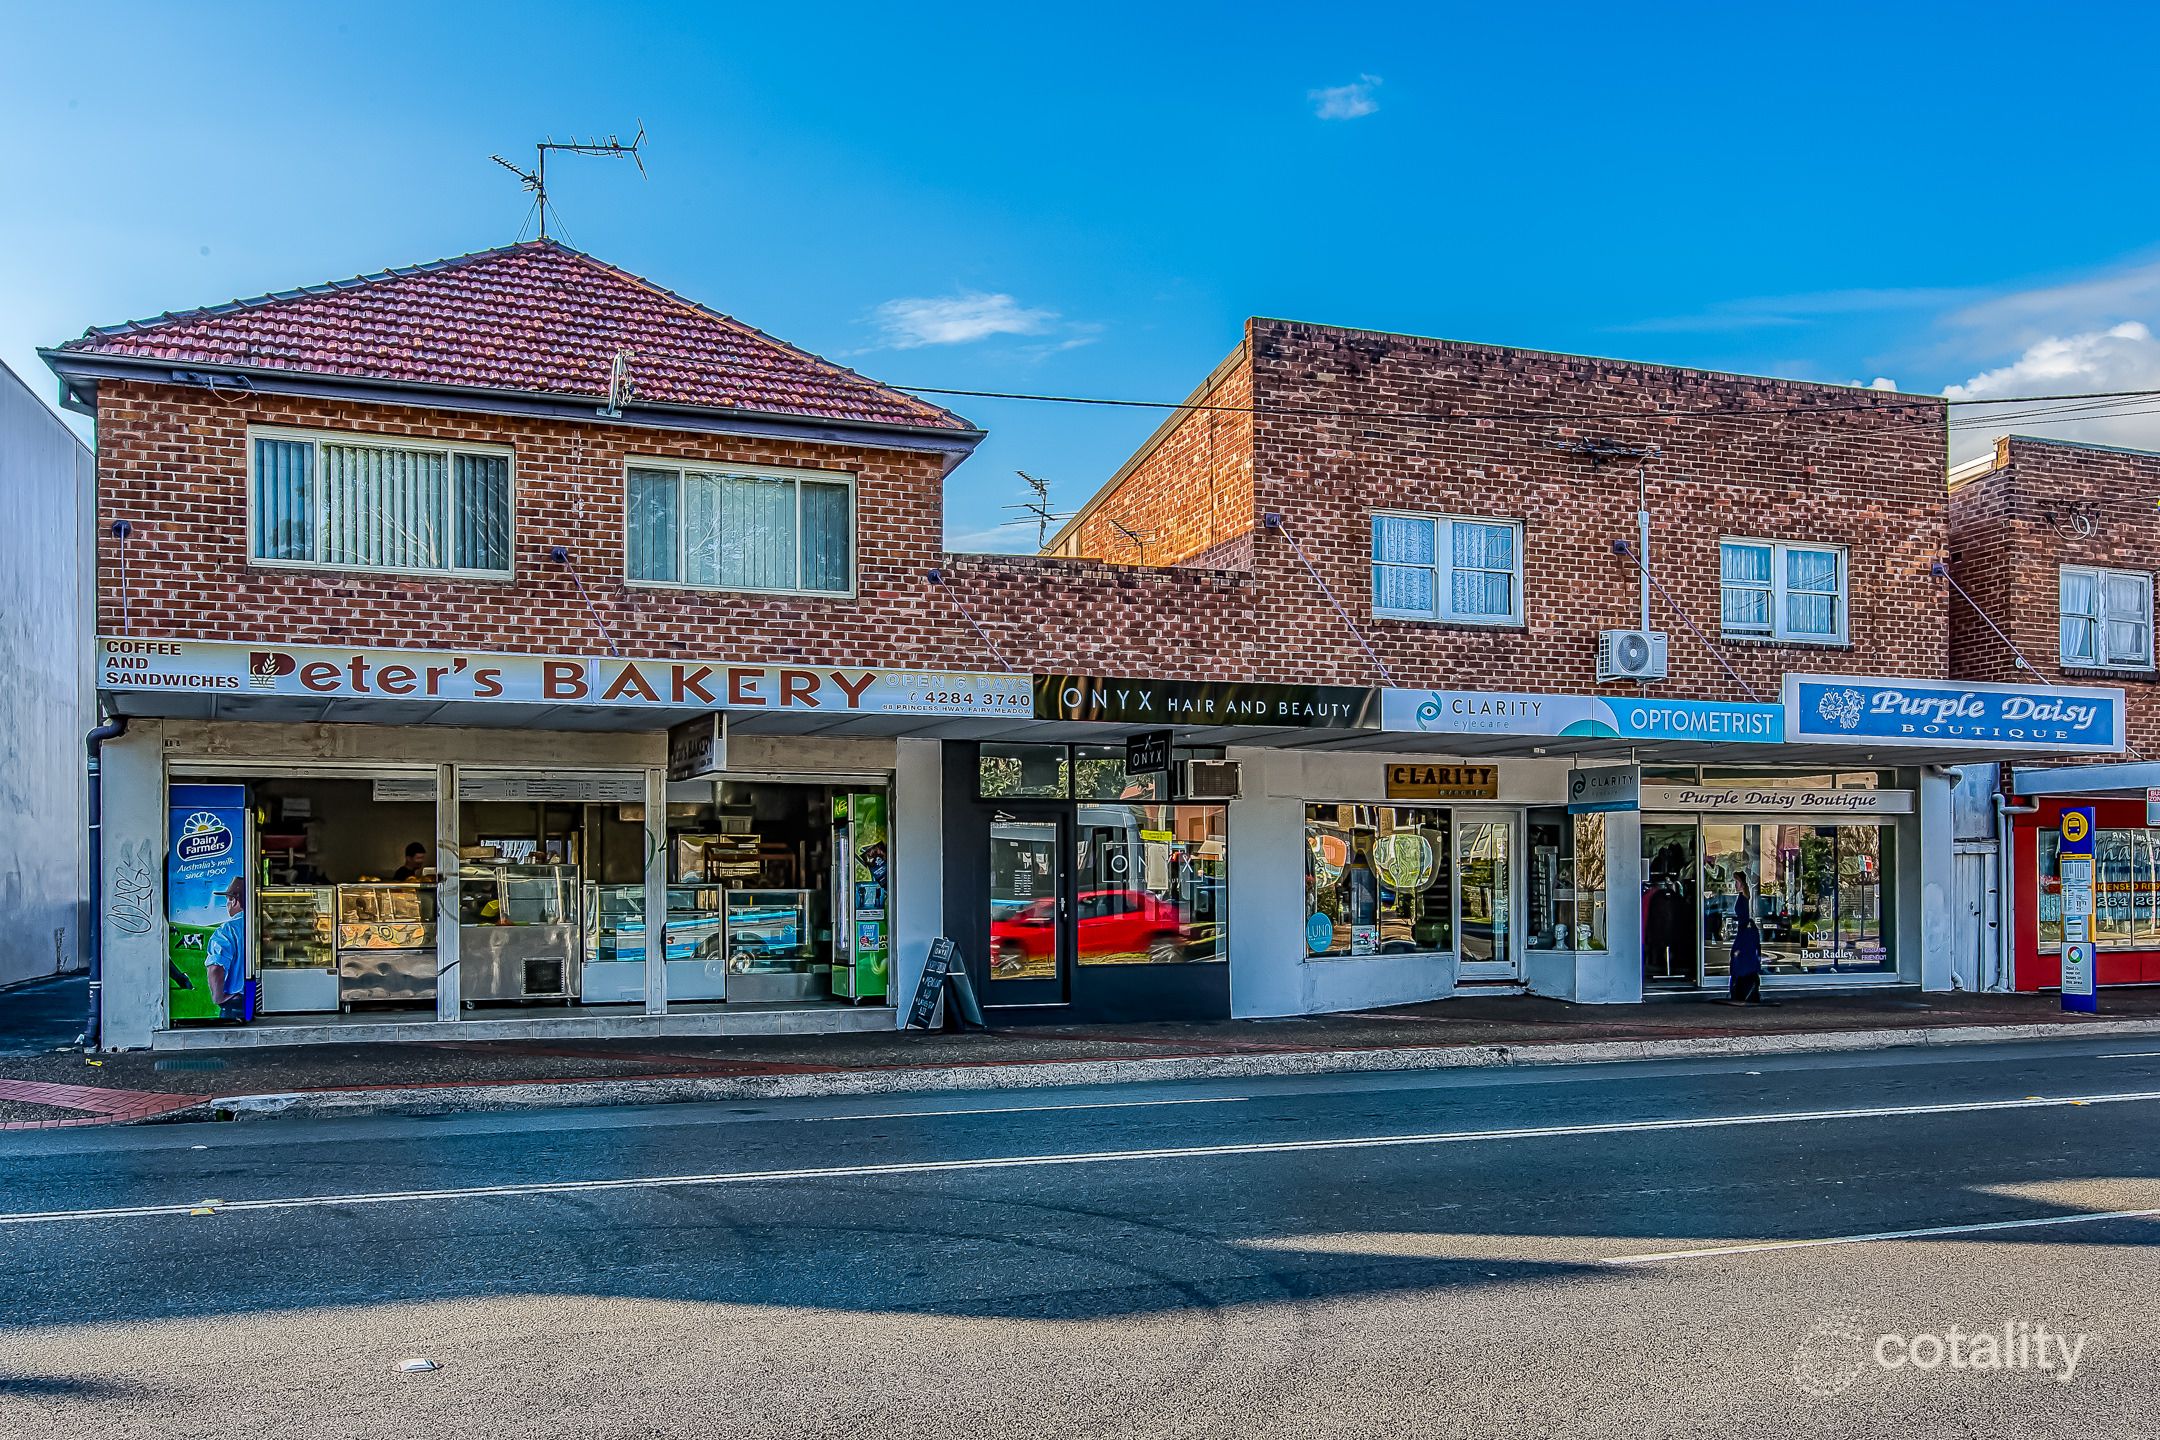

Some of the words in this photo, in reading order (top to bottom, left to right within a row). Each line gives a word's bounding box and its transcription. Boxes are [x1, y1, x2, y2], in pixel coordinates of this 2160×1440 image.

[106, 640, 182, 656] COFFEE
[106, 656, 150, 669] AND
[105, 672, 240, 688] SANDWICHES
[249, 650, 504, 698] Peter's
[542, 661, 878, 709] BAKERY
[884, 673, 945, 688] OPEN
[954, 676, 967, 689] 6
[976, 677, 1032, 691] DAYS
[924, 691, 974, 705] 4284
[982, 693, 1031, 707] 3740
[1063, 687, 1152, 711] ONYX
[1168, 698, 1215, 713] HAIR
[1225, 700, 1267, 715] AND
[1279, 701, 1351, 718] BEAUTY
[1452, 699, 1542, 717] CLARITY
[1869, 690, 1986, 724] Purple
[2002, 698, 2097, 730] Daisy
[1453, 719, 1510, 731] eyecare
[1631, 707, 1774, 735] OPTOMETRIST
[1901, 723, 2069, 740] BOUTIQUE
[1132, 749, 1162, 767] ONYX
[1393, 767, 1492, 785] CLARITY
[1591, 775, 1634, 787] CLARITY
[1679, 790, 1739, 808] Purple
[1744, 792, 1796, 809] Daisy
[1800, 793, 1877, 810] Boutique
[186, 842, 225, 854] Farmers
[192, 836, 219, 846] Dairy
[177, 861, 217, 873] Australia's
[217, 857, 235, 867] milk
[185, 871, 205, 879] since
[207, 868, 227, 877] 1900
[1801, 949, 1820, 959] Boo
[1823, 948, 1853, 960] Radley
